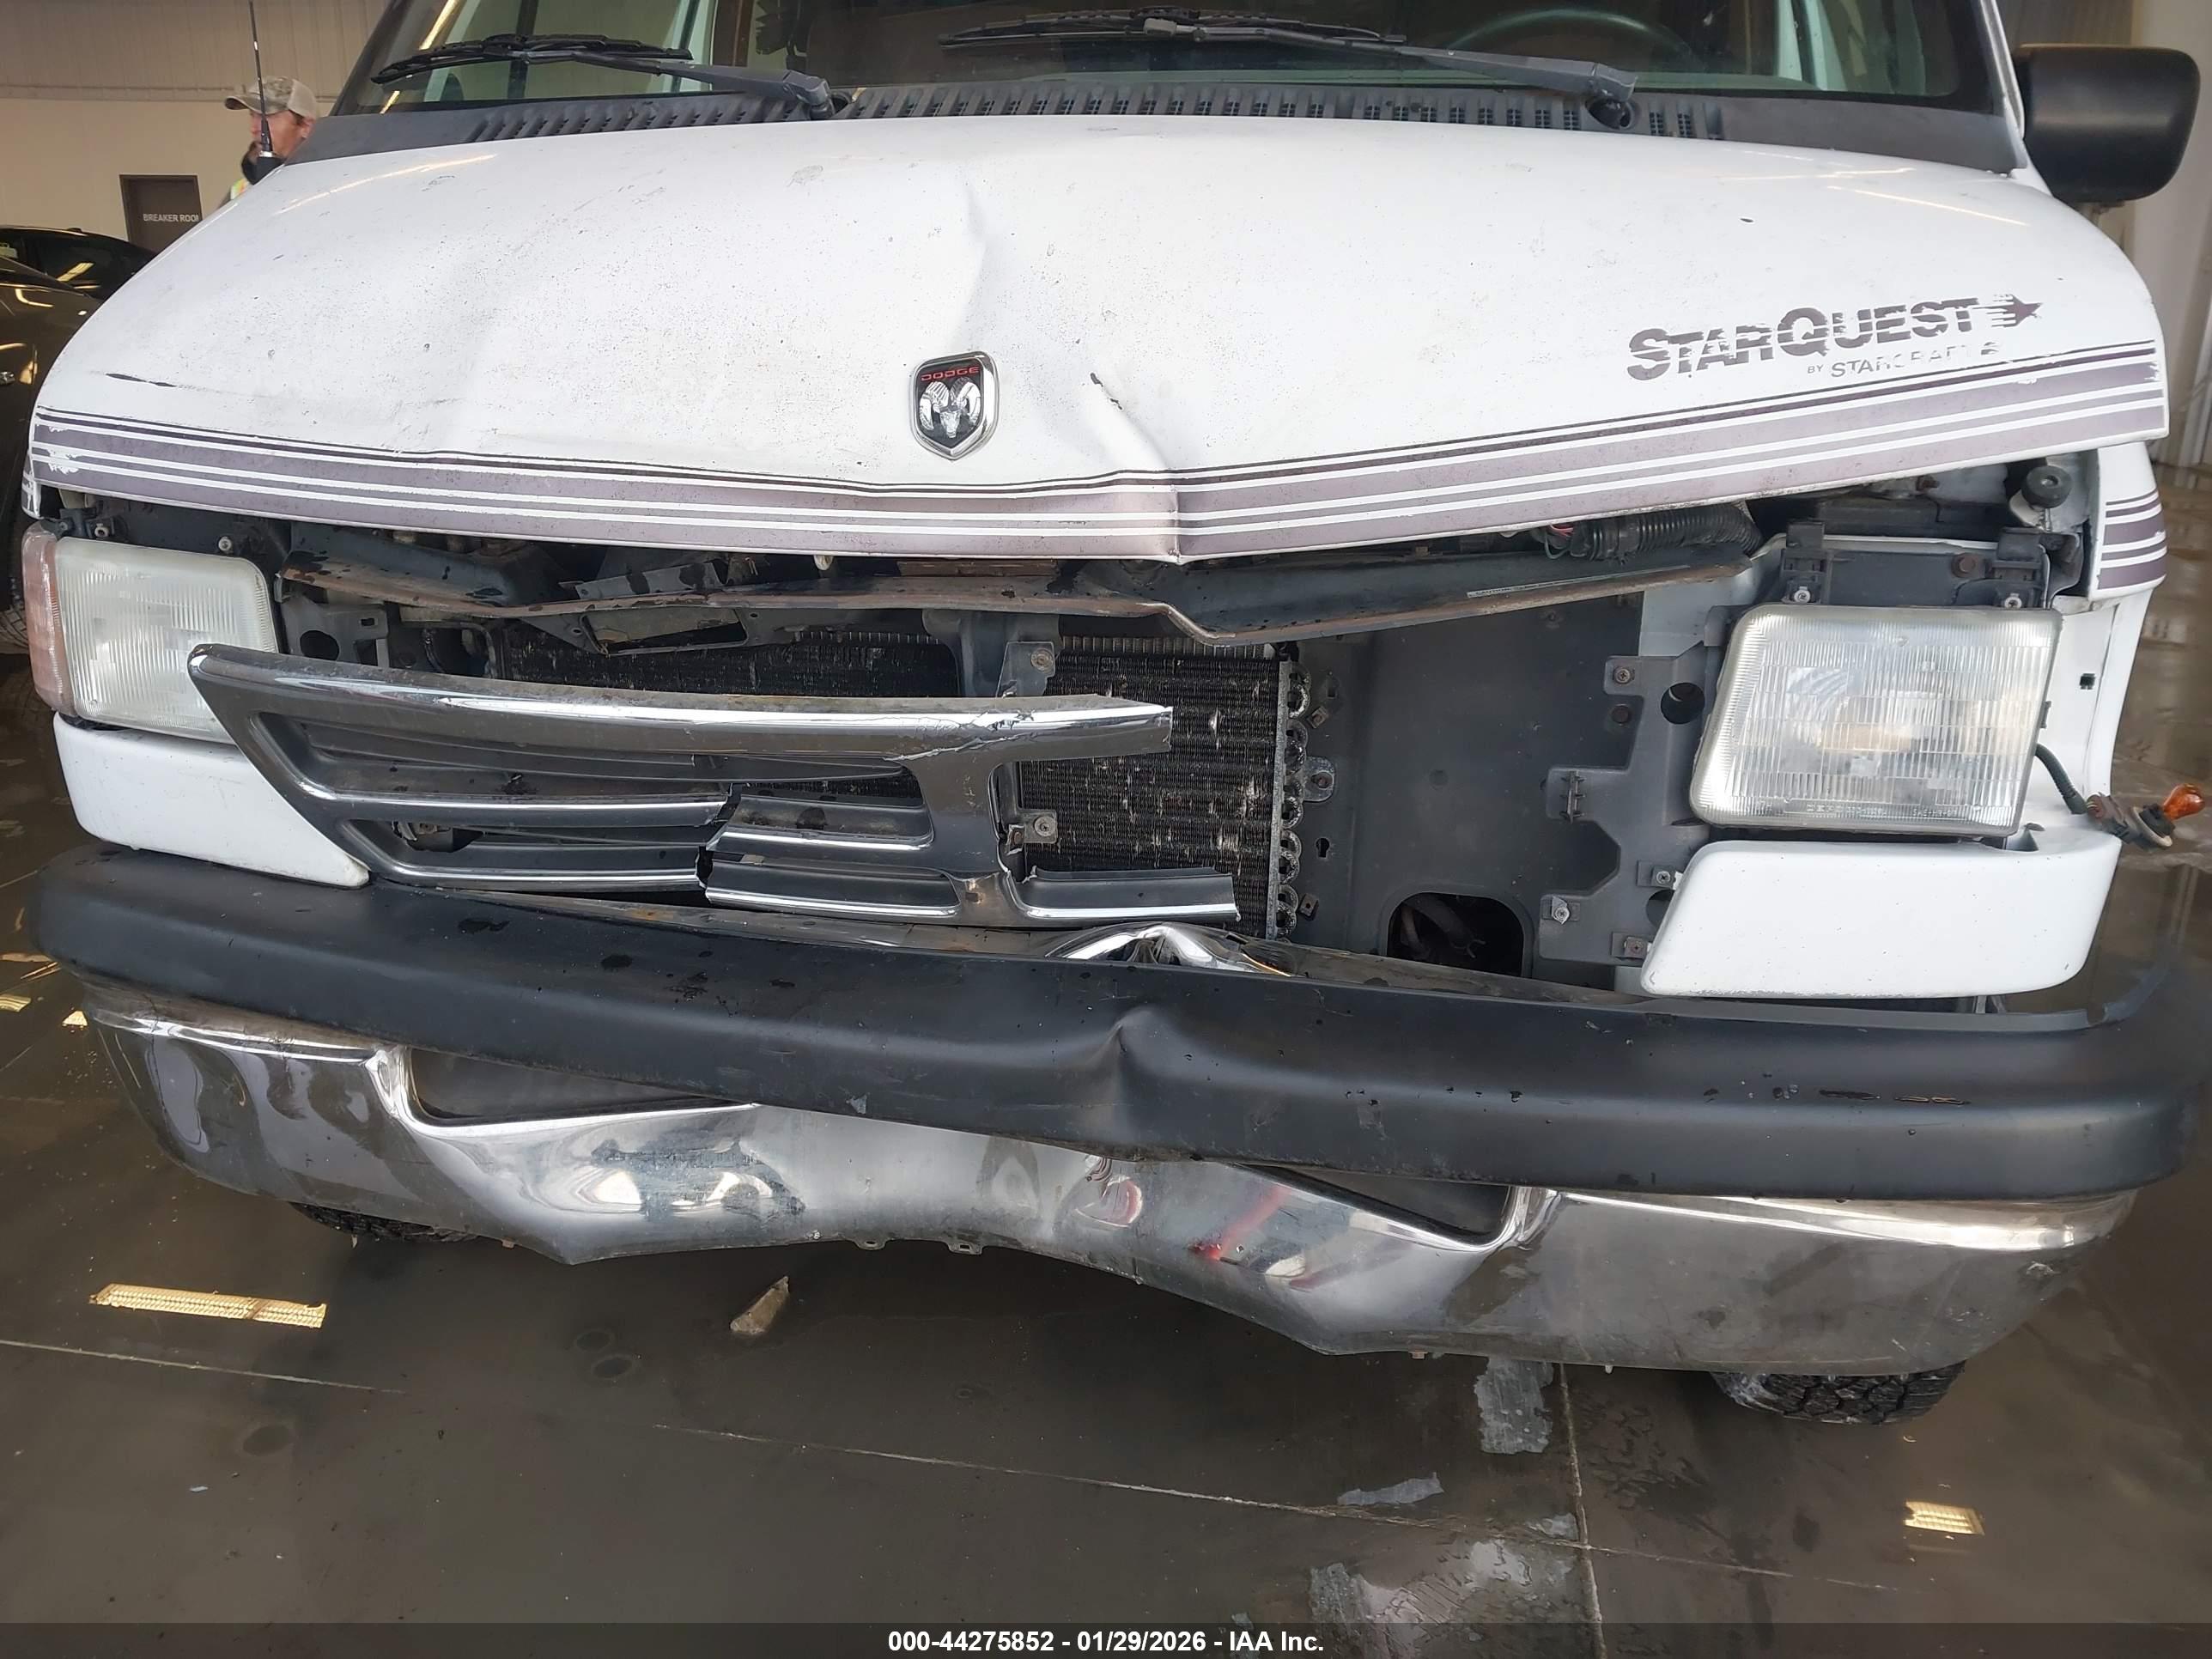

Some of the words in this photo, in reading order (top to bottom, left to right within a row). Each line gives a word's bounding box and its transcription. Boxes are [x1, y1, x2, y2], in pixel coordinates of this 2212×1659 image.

[143, 213, 179, 222] BREAKER
[921, 366, 980, 381] DODGE
[1807, 364, 1824, 374] BY
